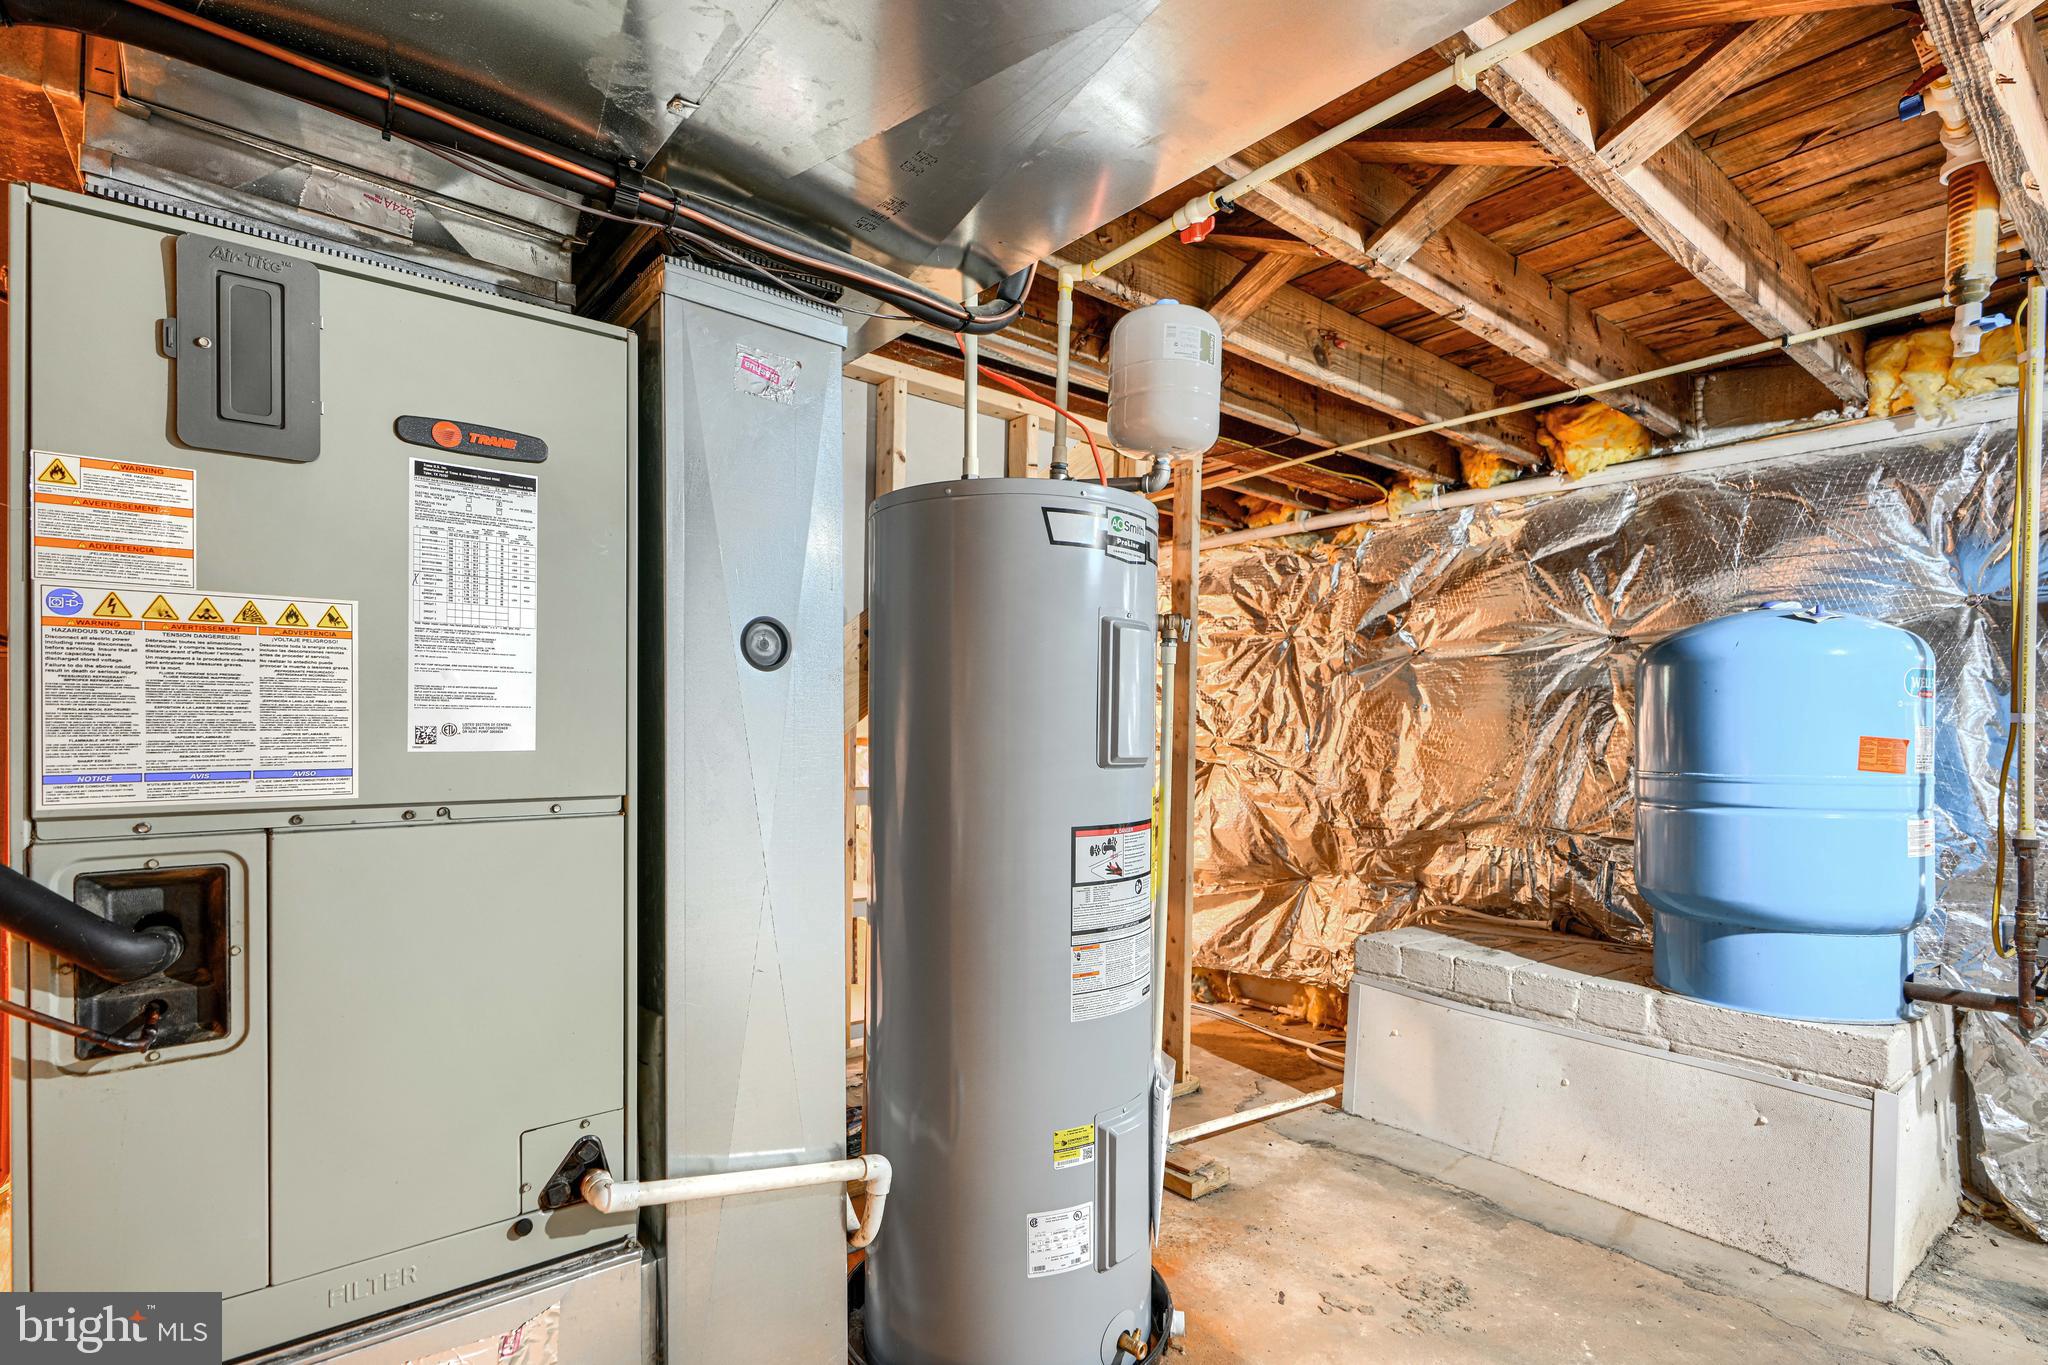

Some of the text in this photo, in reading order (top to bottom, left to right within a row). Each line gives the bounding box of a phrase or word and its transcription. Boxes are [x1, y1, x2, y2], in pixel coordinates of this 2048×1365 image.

[384, 196, 414, 219] 324A
[209, 245, 284, 273] Air-Tite
[468, 432, 517, 449] TRANE
[120, 464, 163, 474] WARNING
[82, 499, 159, 512] AVERTISSEMENT
[88, 542, 154, 553] ADVERTENCIA
[170, 624, 240, 632] AVERTISSEMENT
[327, 1265, 416, 1309] FILTER
